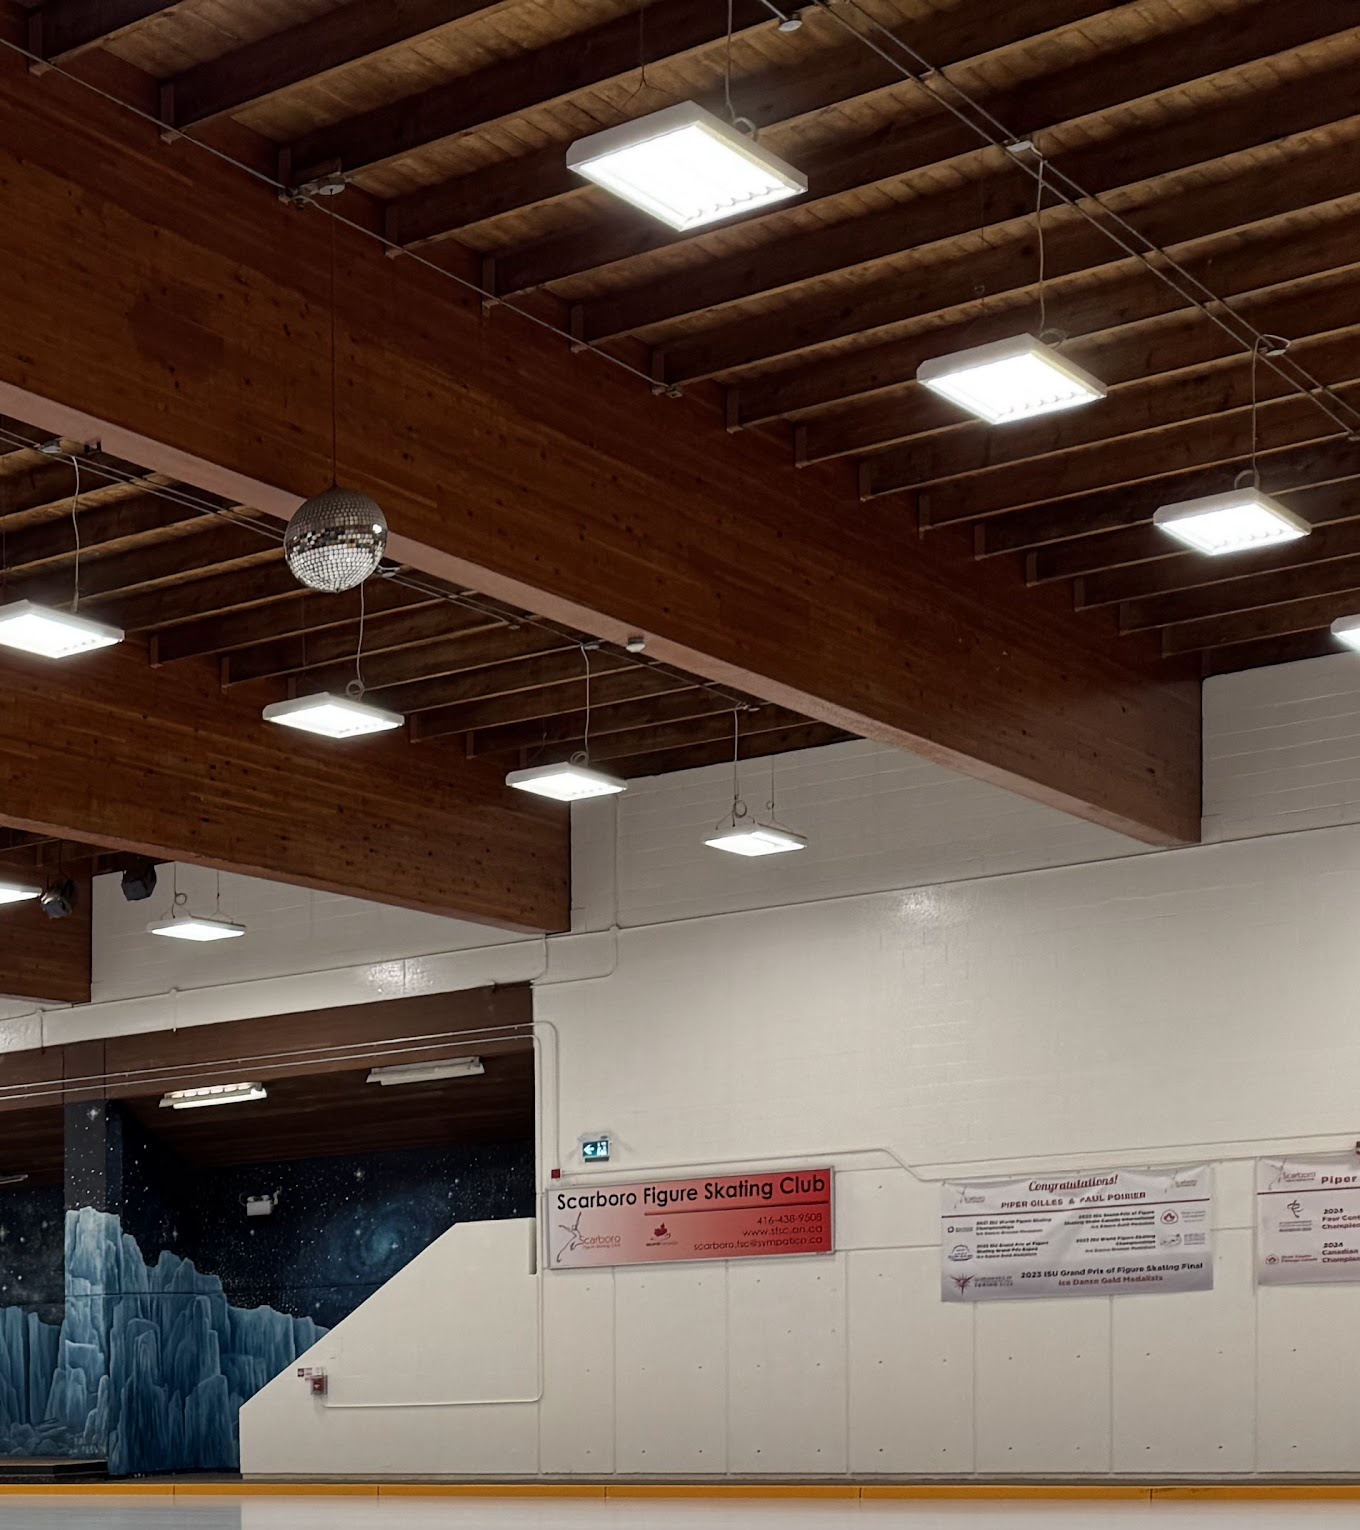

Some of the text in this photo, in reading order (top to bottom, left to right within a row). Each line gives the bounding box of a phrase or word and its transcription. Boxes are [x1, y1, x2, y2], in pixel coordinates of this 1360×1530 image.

[557, 1174, 825, 1210] Scarboro Figure Skating Club
[1028, 1174, 1118, 1193] Congratulations!
[1060, 1268, 1086, 1277] Grand
[1117, 1265, 1145, 1274] Figure
[1146, 1264, 1180, 1272] Skating
